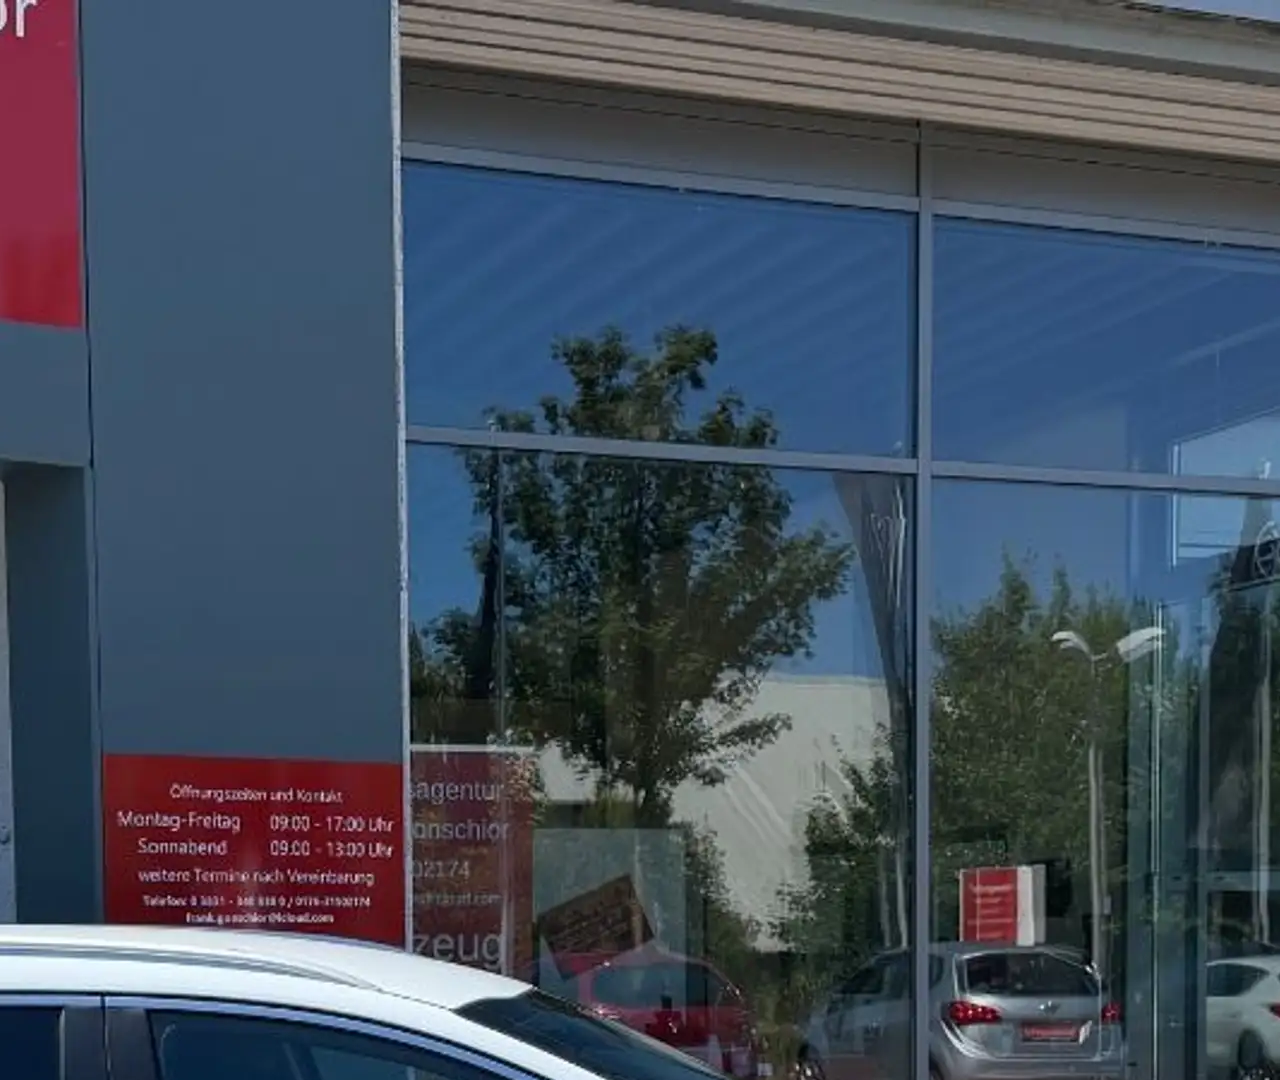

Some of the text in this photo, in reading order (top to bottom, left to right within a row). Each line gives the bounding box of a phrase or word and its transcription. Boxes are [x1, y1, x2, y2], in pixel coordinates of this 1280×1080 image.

[169, 783, 344, 803] Öffnungszeiten und Kontakt
[117, 810, 242, 833] Montag-Freitag
[269, 814, 311, 833] 09:00
[325, 815, 365, 833] 17:00
[368, 815, 395, 833] Uhr
[137, 836, 228, 857] Sonnabend
[269, 839, 311, 857] 09:00
[325, 840, 366, 858] 13:00
[368, 840, 395, 859] Uhr
[138, 868, 375, 887] weitere Termine nach Vereinbarung
